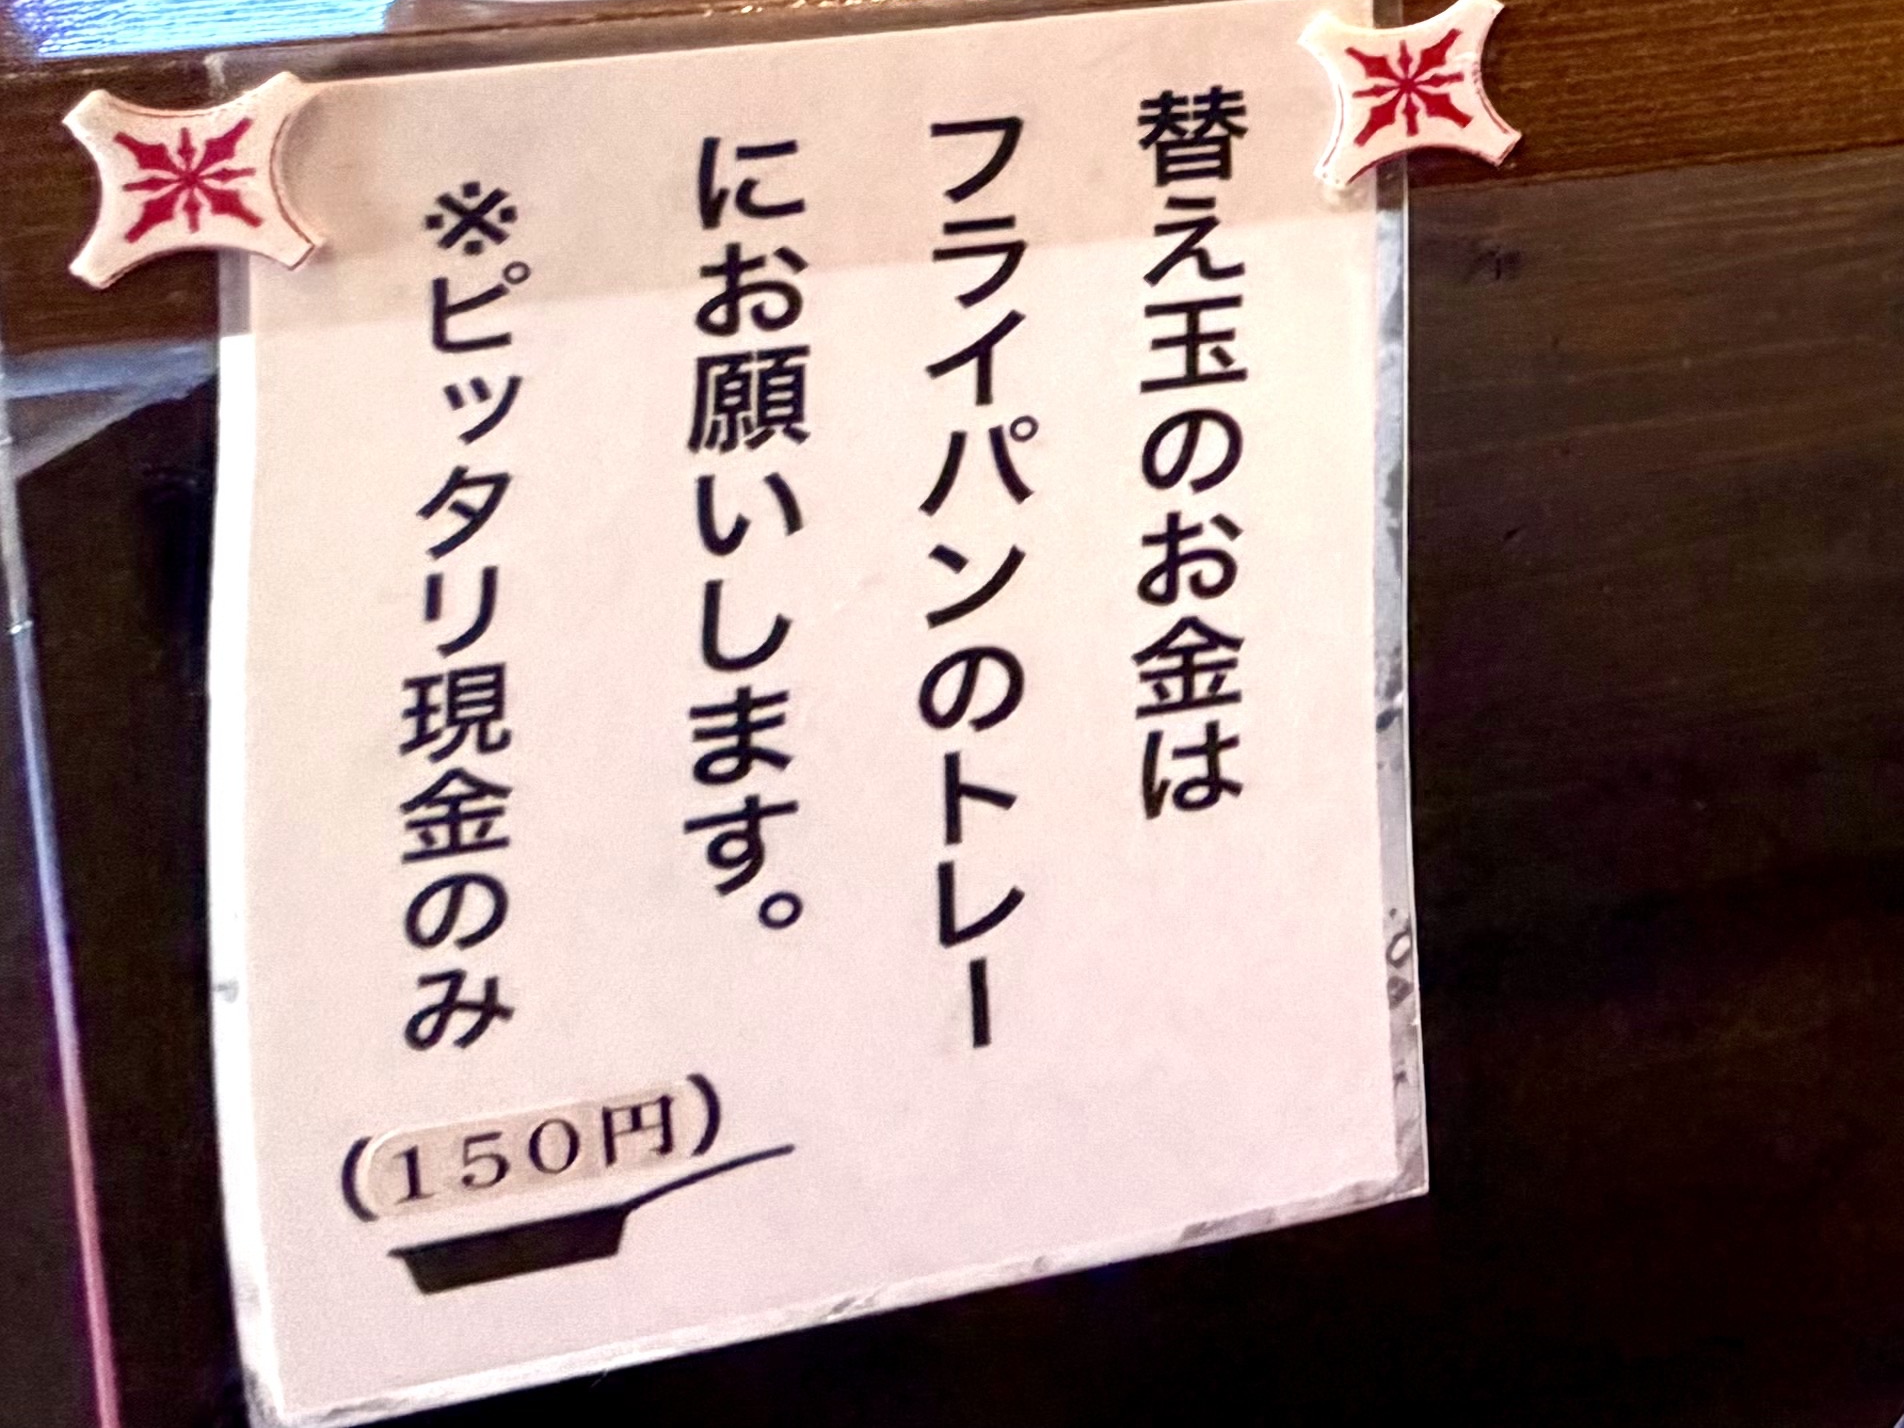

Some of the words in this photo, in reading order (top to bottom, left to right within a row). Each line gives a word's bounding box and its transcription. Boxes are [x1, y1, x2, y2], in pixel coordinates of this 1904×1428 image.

[682, 133, 811, 936] にお願いします。
[917, 115, 1040, 1051] フライパンのトレー
[1135, 86, 1250, 821] 替え玉のお金は
[341, 1072, 721, 1222] (150円)
